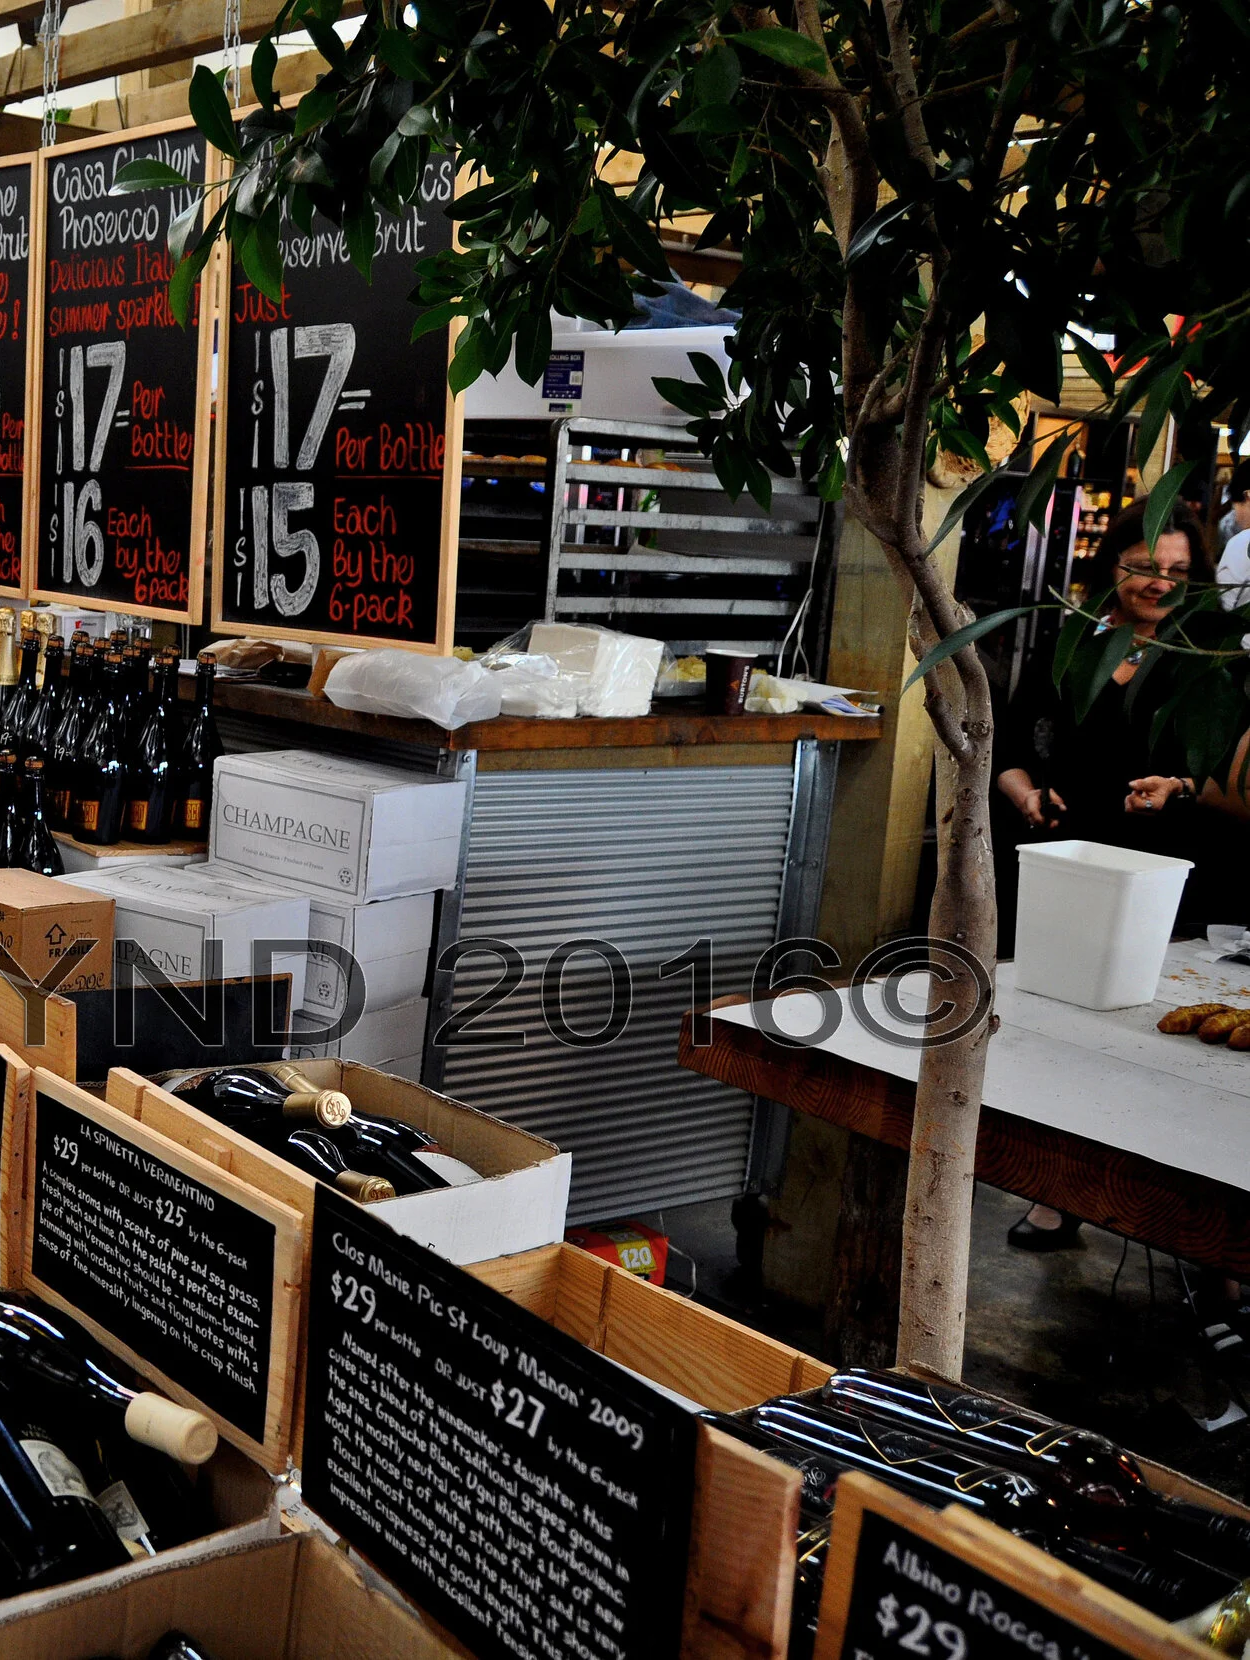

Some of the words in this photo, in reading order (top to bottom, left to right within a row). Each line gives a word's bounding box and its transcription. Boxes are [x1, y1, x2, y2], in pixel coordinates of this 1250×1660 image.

[53, 161, 107, 203] Casa
[59, 205, 158, 249] Prosecco
[51, 254, 125, 293] Delicious
[50, 301, 111, 337] summer
[235, 283, 292, 323] Just
[133, 380, 165, 420] Per
[2, 412, 24, 440] Per
[131, 421, 192, 460] Bottle
[335, 426, 373, 469] Per
[380, 422, 447, 471] Bottle
[49, 478, 104, 587] $16
[107, 505, 152, 538] Each
[333, 495, 397, 535] Each
[116, 540, 139, 579] by
[145, 537, 181, 575] the
[234, 482, 320, 617] $15
[333, 539, 363, 587] By
[370, 541, 414, 584] the
[329, 585, 413, 630] 6-pack
[223, 804, 350, 850] CHAMPAGNE
[80, 1124, 91, 1140] LA
[93, 1130, 140, 1169] SPINETTA
[142, 1158, 214, 1211] VERMENTINO
[53, 1134, 78, 1165] $29
[81, 1162, 91, 1173] per
[92, 1166, 115, 1188] bottle
[118, 1181, 130, 1197] OR
[132, 1191, 153, 1210] JUST
[155, 1196, 186, 1227] $25
[188, 1225, 198, 1242] by
[201, 1231, 214, 1249] the
[216, 1242, 246, 1269] 6-pack
[42, 1160, 47, 1173] A
[49, 1168, 76, 1194] complex
[77, 1188, 101, 1211] aroma
[103, 1205, 122, 1225] with
[123, 1218, 155, 1244] scents
[157, 1238, 170, 1252] of
[170, 1246, 189, 1265] pine
[190, 1260, 207, 1277] and
[208, 1271, 225, 1290] sea
[618, 1247, 652, 1268] 120
[332, 1232, 364, 1265] Clos
[417, 1284, 442, 1316] Pic
[447, 1305, 468, 1331] St
[471, 1323, 509, 1364] Loup
[589, 1397, 643, 1449] 2009
[330, 1270, 376, 1324] $29
[374, 1318, 390, 1334] per
[391, 1326, 420, 1357] bottle
[435, 1357, 451, 1379] OR
[456, 1373, 486, 1400] JUST
[489, 1379, 545, 1437] $27
[548, 1435, 562, 1458] by
[566, 1447, 586, 1473] the
[590, 1466, 637, 1508] 6-pack
[342, 1331, 377, 1368] Named
[379, 1362, 410, 1391] after
[413, 1382, 434, 1409] the
[438, 1405, 510, 1465] winemaker's
[583, 1504, 612, 1540] this
[883, 1541, 962, 1604] Albino
[876, 1592, 968, 1660] $29
